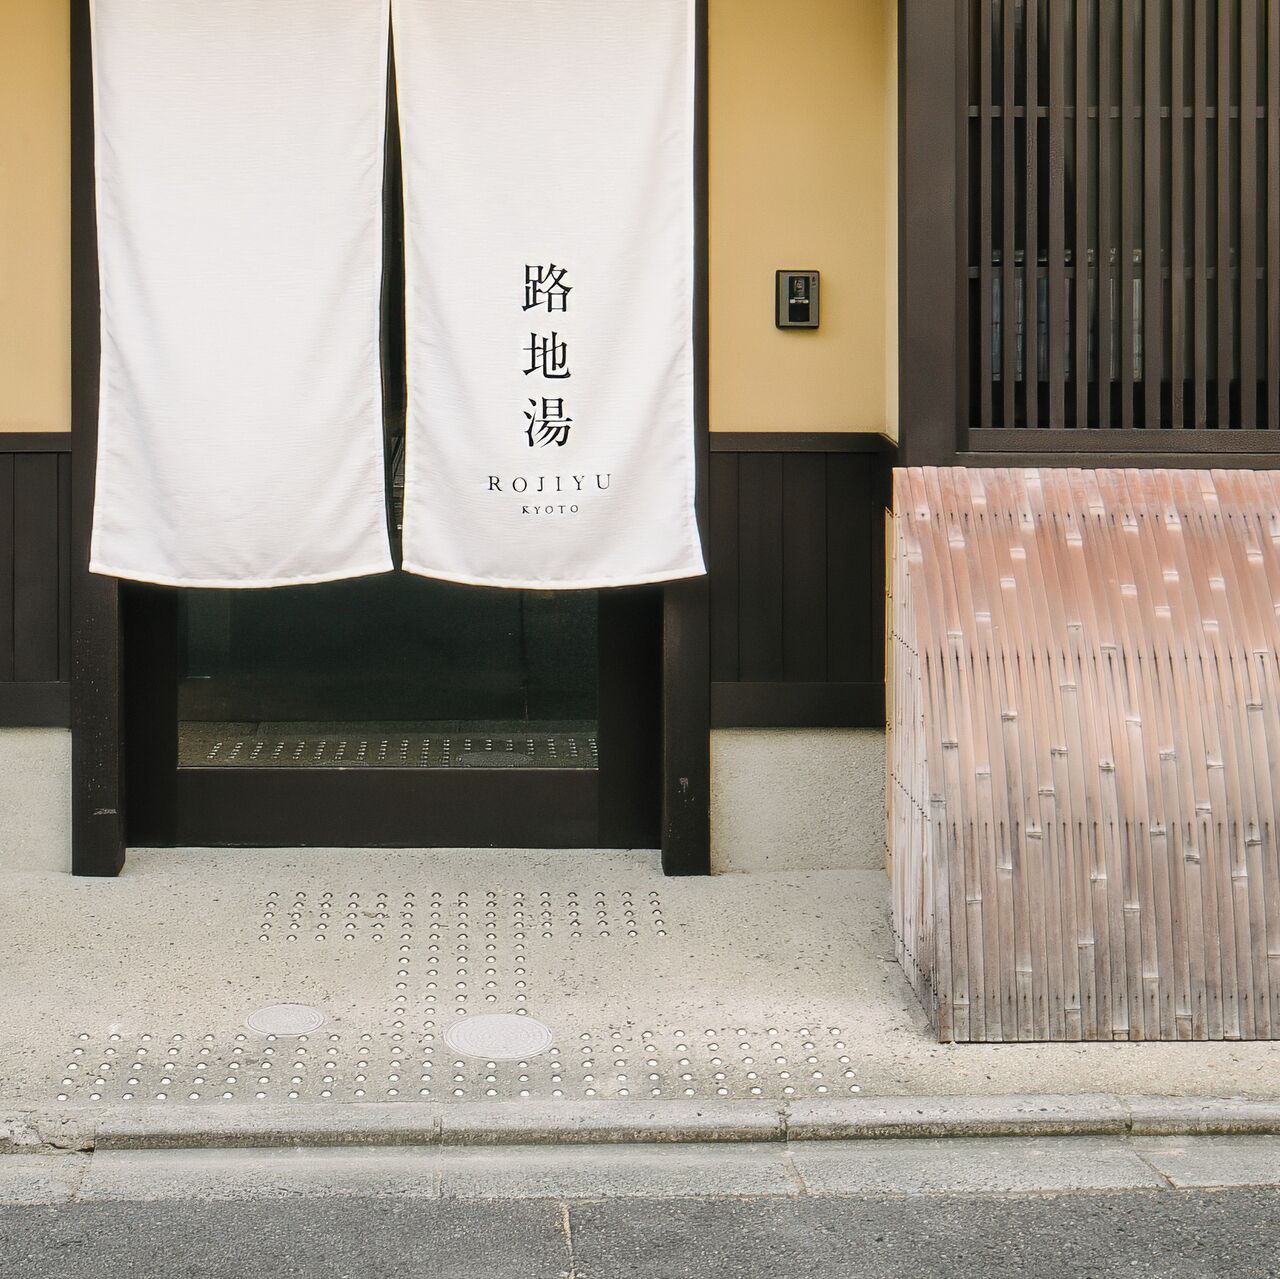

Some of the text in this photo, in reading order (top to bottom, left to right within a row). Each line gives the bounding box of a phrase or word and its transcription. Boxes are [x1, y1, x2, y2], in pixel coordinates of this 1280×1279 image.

[521, 263, 573, 448] 路地湯
[488, 473, 612, 493] ROJIYU
[522, 504, 579, 515] KYOTO
